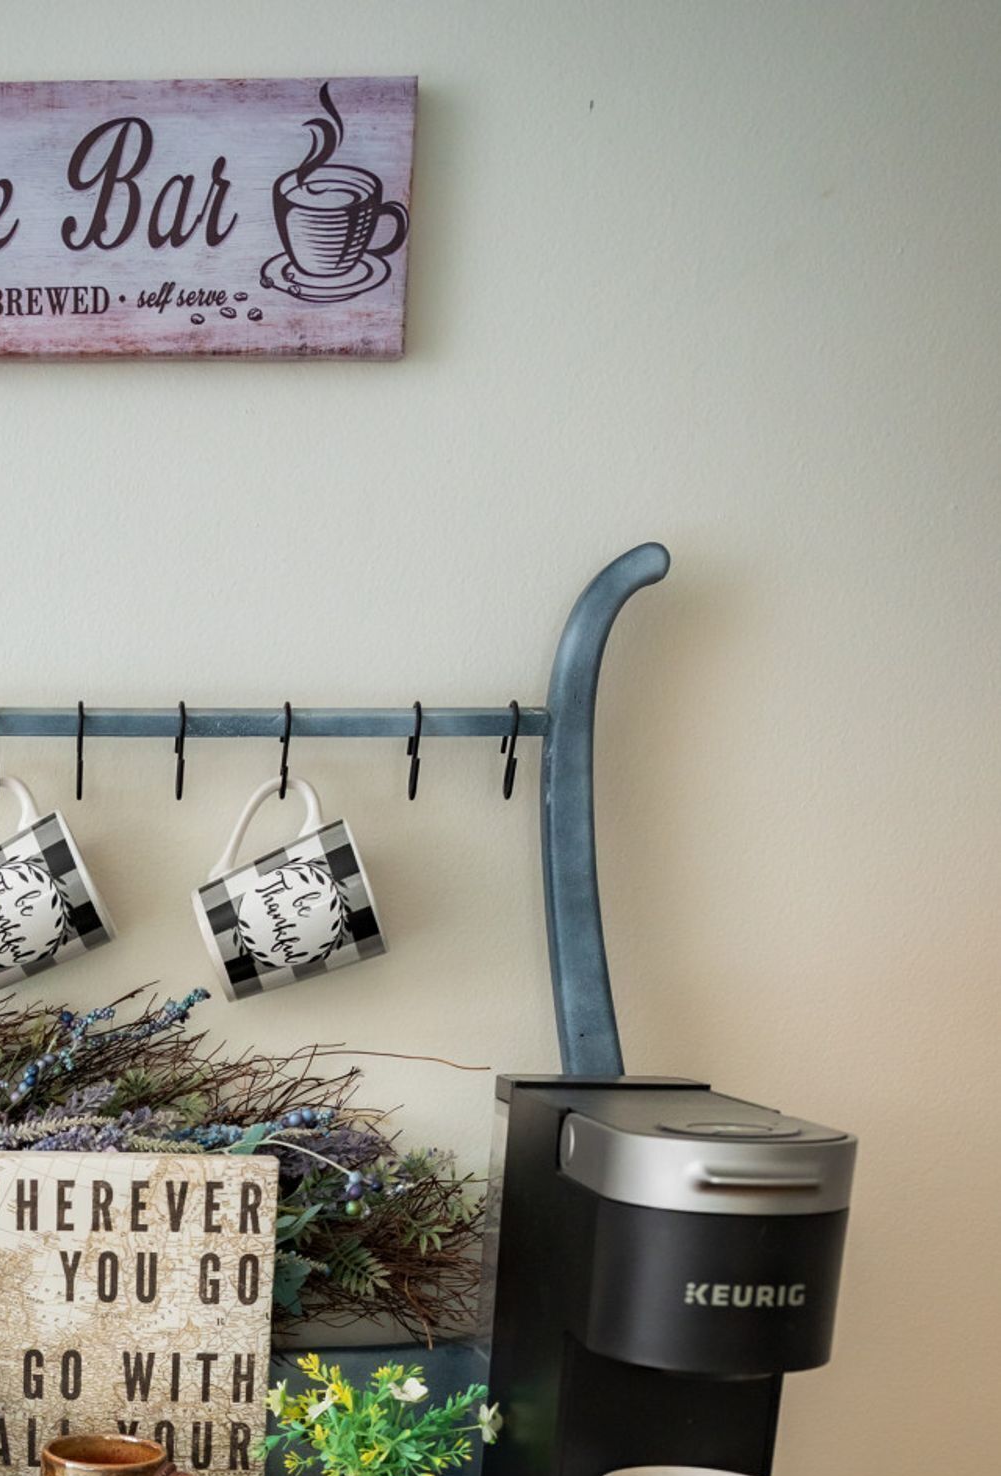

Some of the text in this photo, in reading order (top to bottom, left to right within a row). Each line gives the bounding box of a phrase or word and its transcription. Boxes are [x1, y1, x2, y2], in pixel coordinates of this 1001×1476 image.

[60, 117, 238, 251] Bar
[136, 281, 176, 314] self
[176, 287, 228, 307] serve
[14, 890, 42, 917] be
[255, 869, 309, 964] Thankful
[292, 891, 322, 918] be
[59, 1250, 260, 1306] YOU GO
[684, 1282, 806, 1308] KEURIG
[23, 1348, 256, 1403] GO WITH
